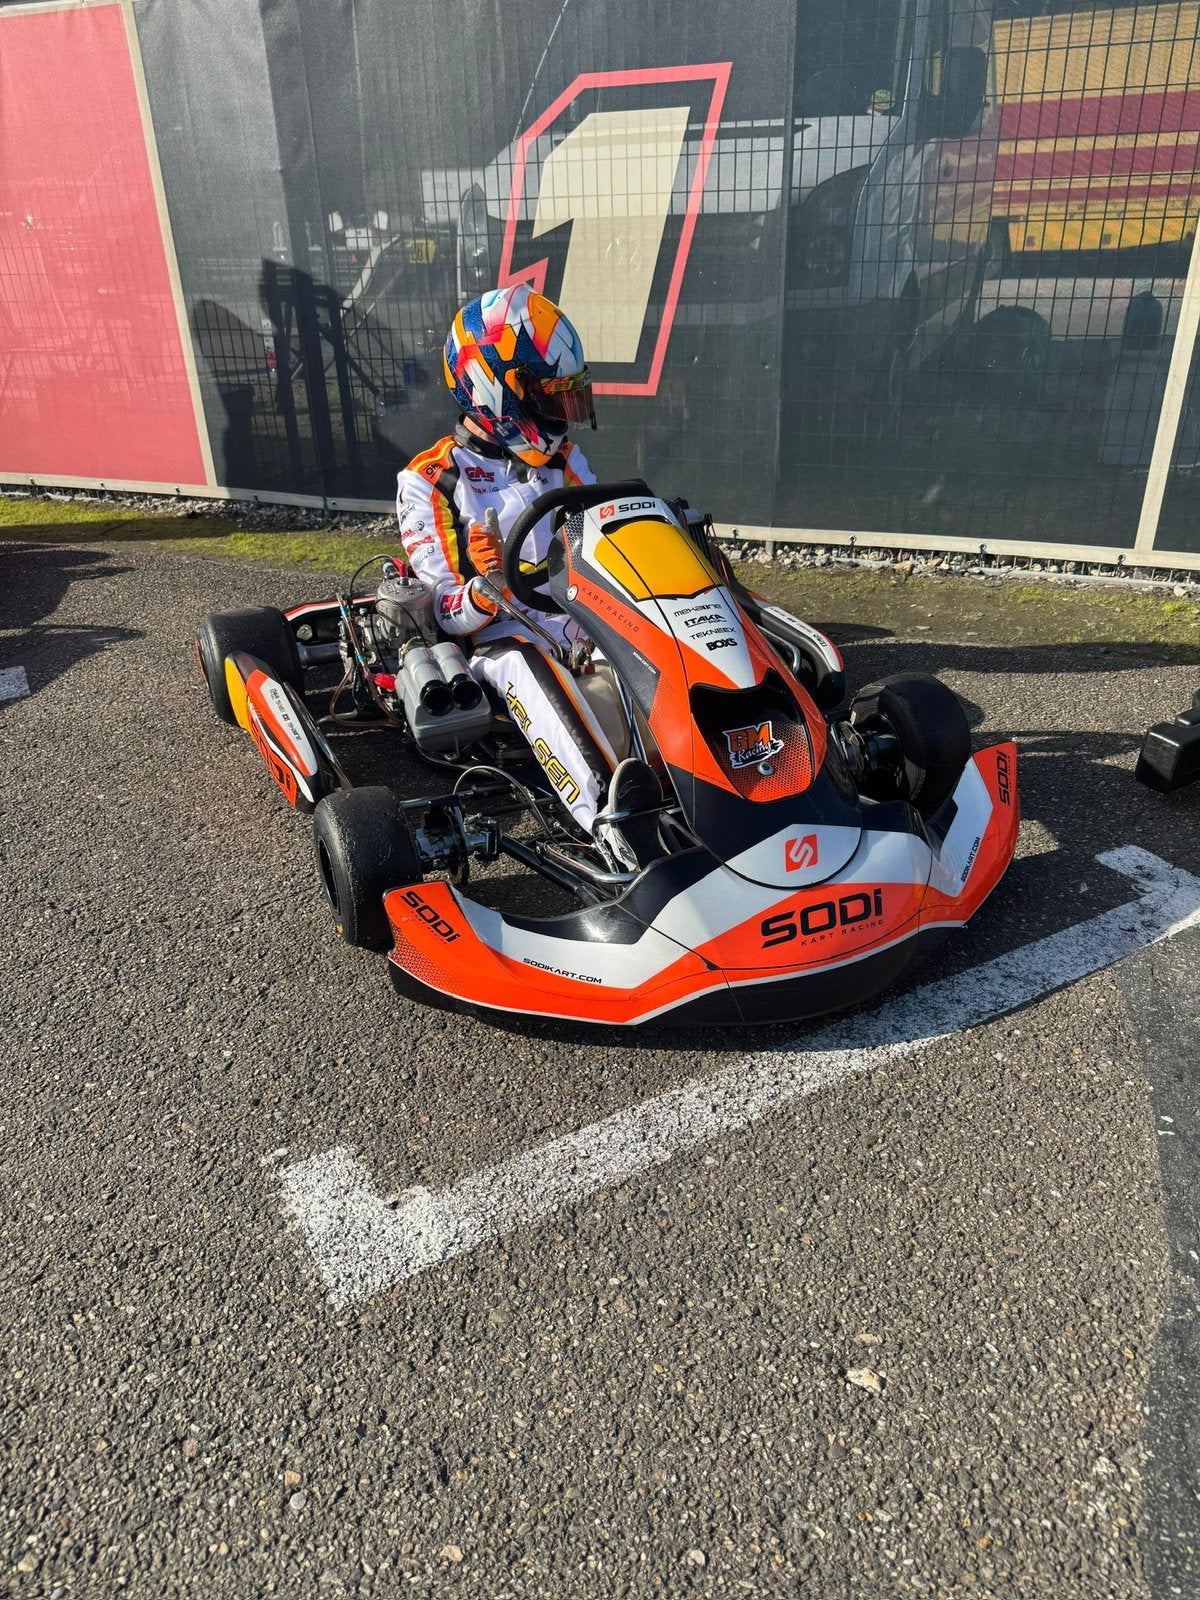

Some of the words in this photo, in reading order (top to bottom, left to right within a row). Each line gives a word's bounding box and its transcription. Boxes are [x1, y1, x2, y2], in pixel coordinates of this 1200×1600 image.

[532, 106, 690, 364] 1
[581, 586, 605, 607] KART
[606, 605, 641, 633] RACING
[684, 613, 726, 628] ITAKA
[801, 932, 835, 947] KART
[841, 920, 884, 936] RACING
[522, 957, 603, 985] SODIKART.COM
